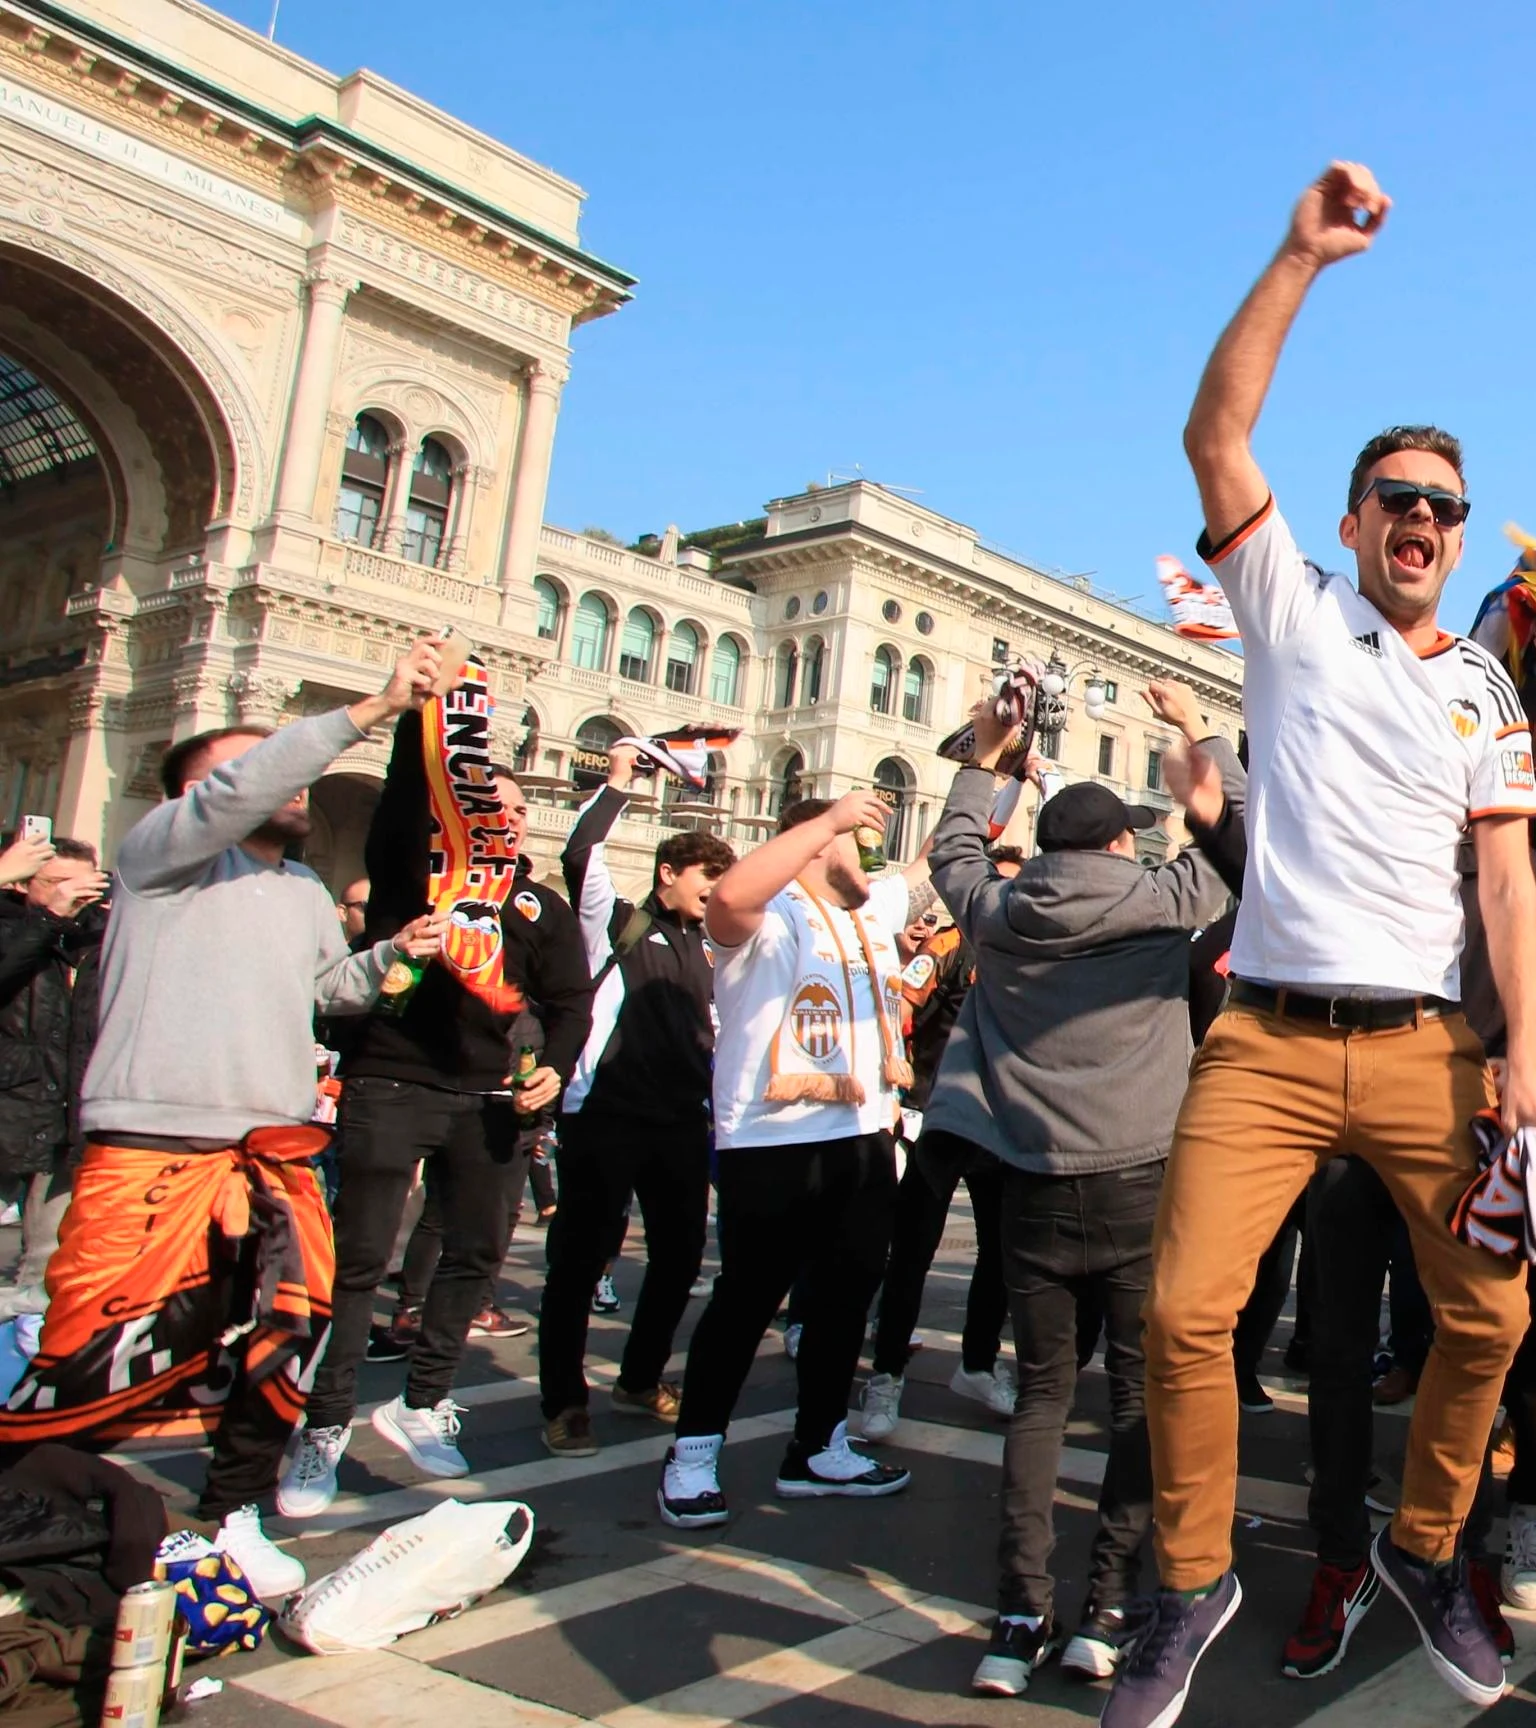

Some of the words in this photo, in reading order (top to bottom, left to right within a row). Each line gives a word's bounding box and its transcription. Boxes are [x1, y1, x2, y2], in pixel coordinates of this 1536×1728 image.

[183, 171, 280, 224] MILANESI
[1349, 638, 1384, 659] adidas
[442, 682, 504, 817] ENCIA
